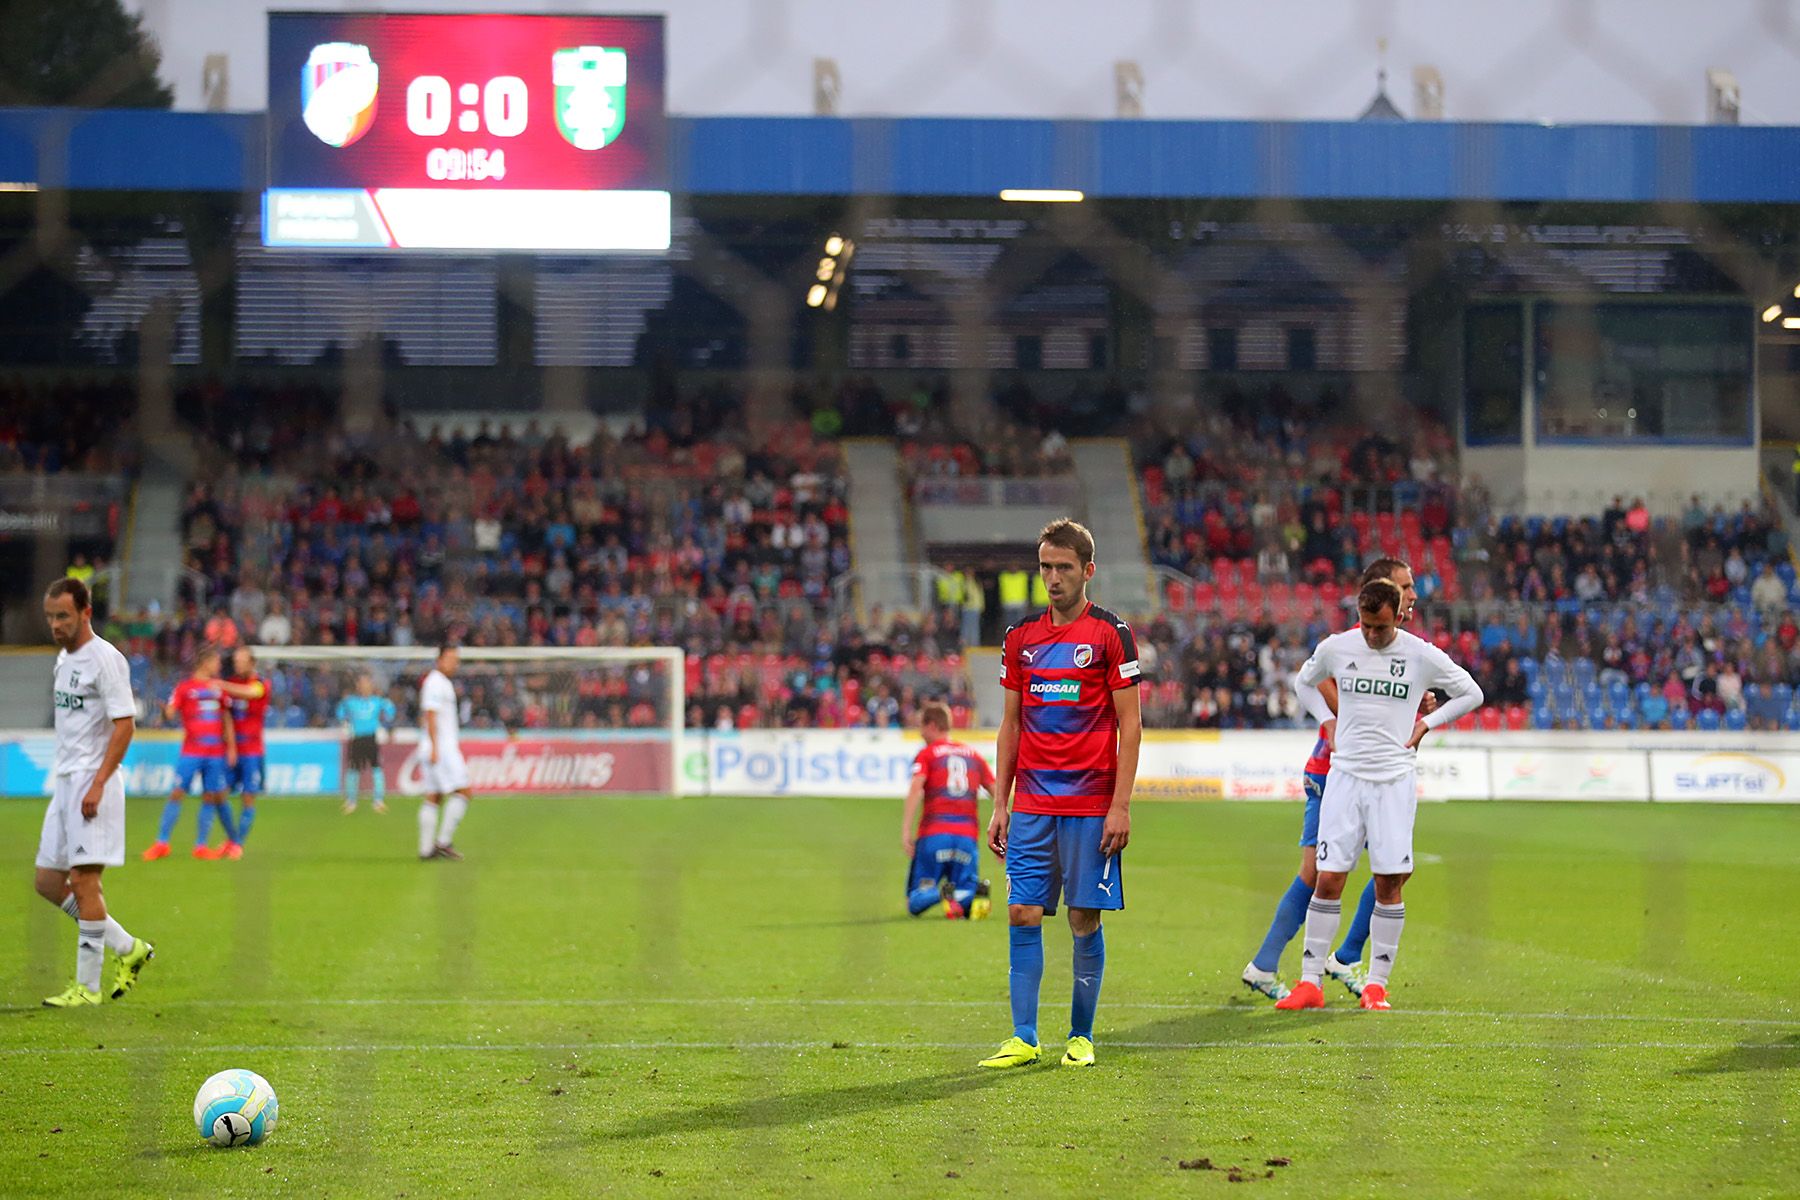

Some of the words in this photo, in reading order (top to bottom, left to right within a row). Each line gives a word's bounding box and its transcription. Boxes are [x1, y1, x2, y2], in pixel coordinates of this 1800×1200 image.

[406, 75, 529, 137] 0:0
[1029, 683, 1080, 694] DOOSAN
[947, 755, 969, 797] 8
